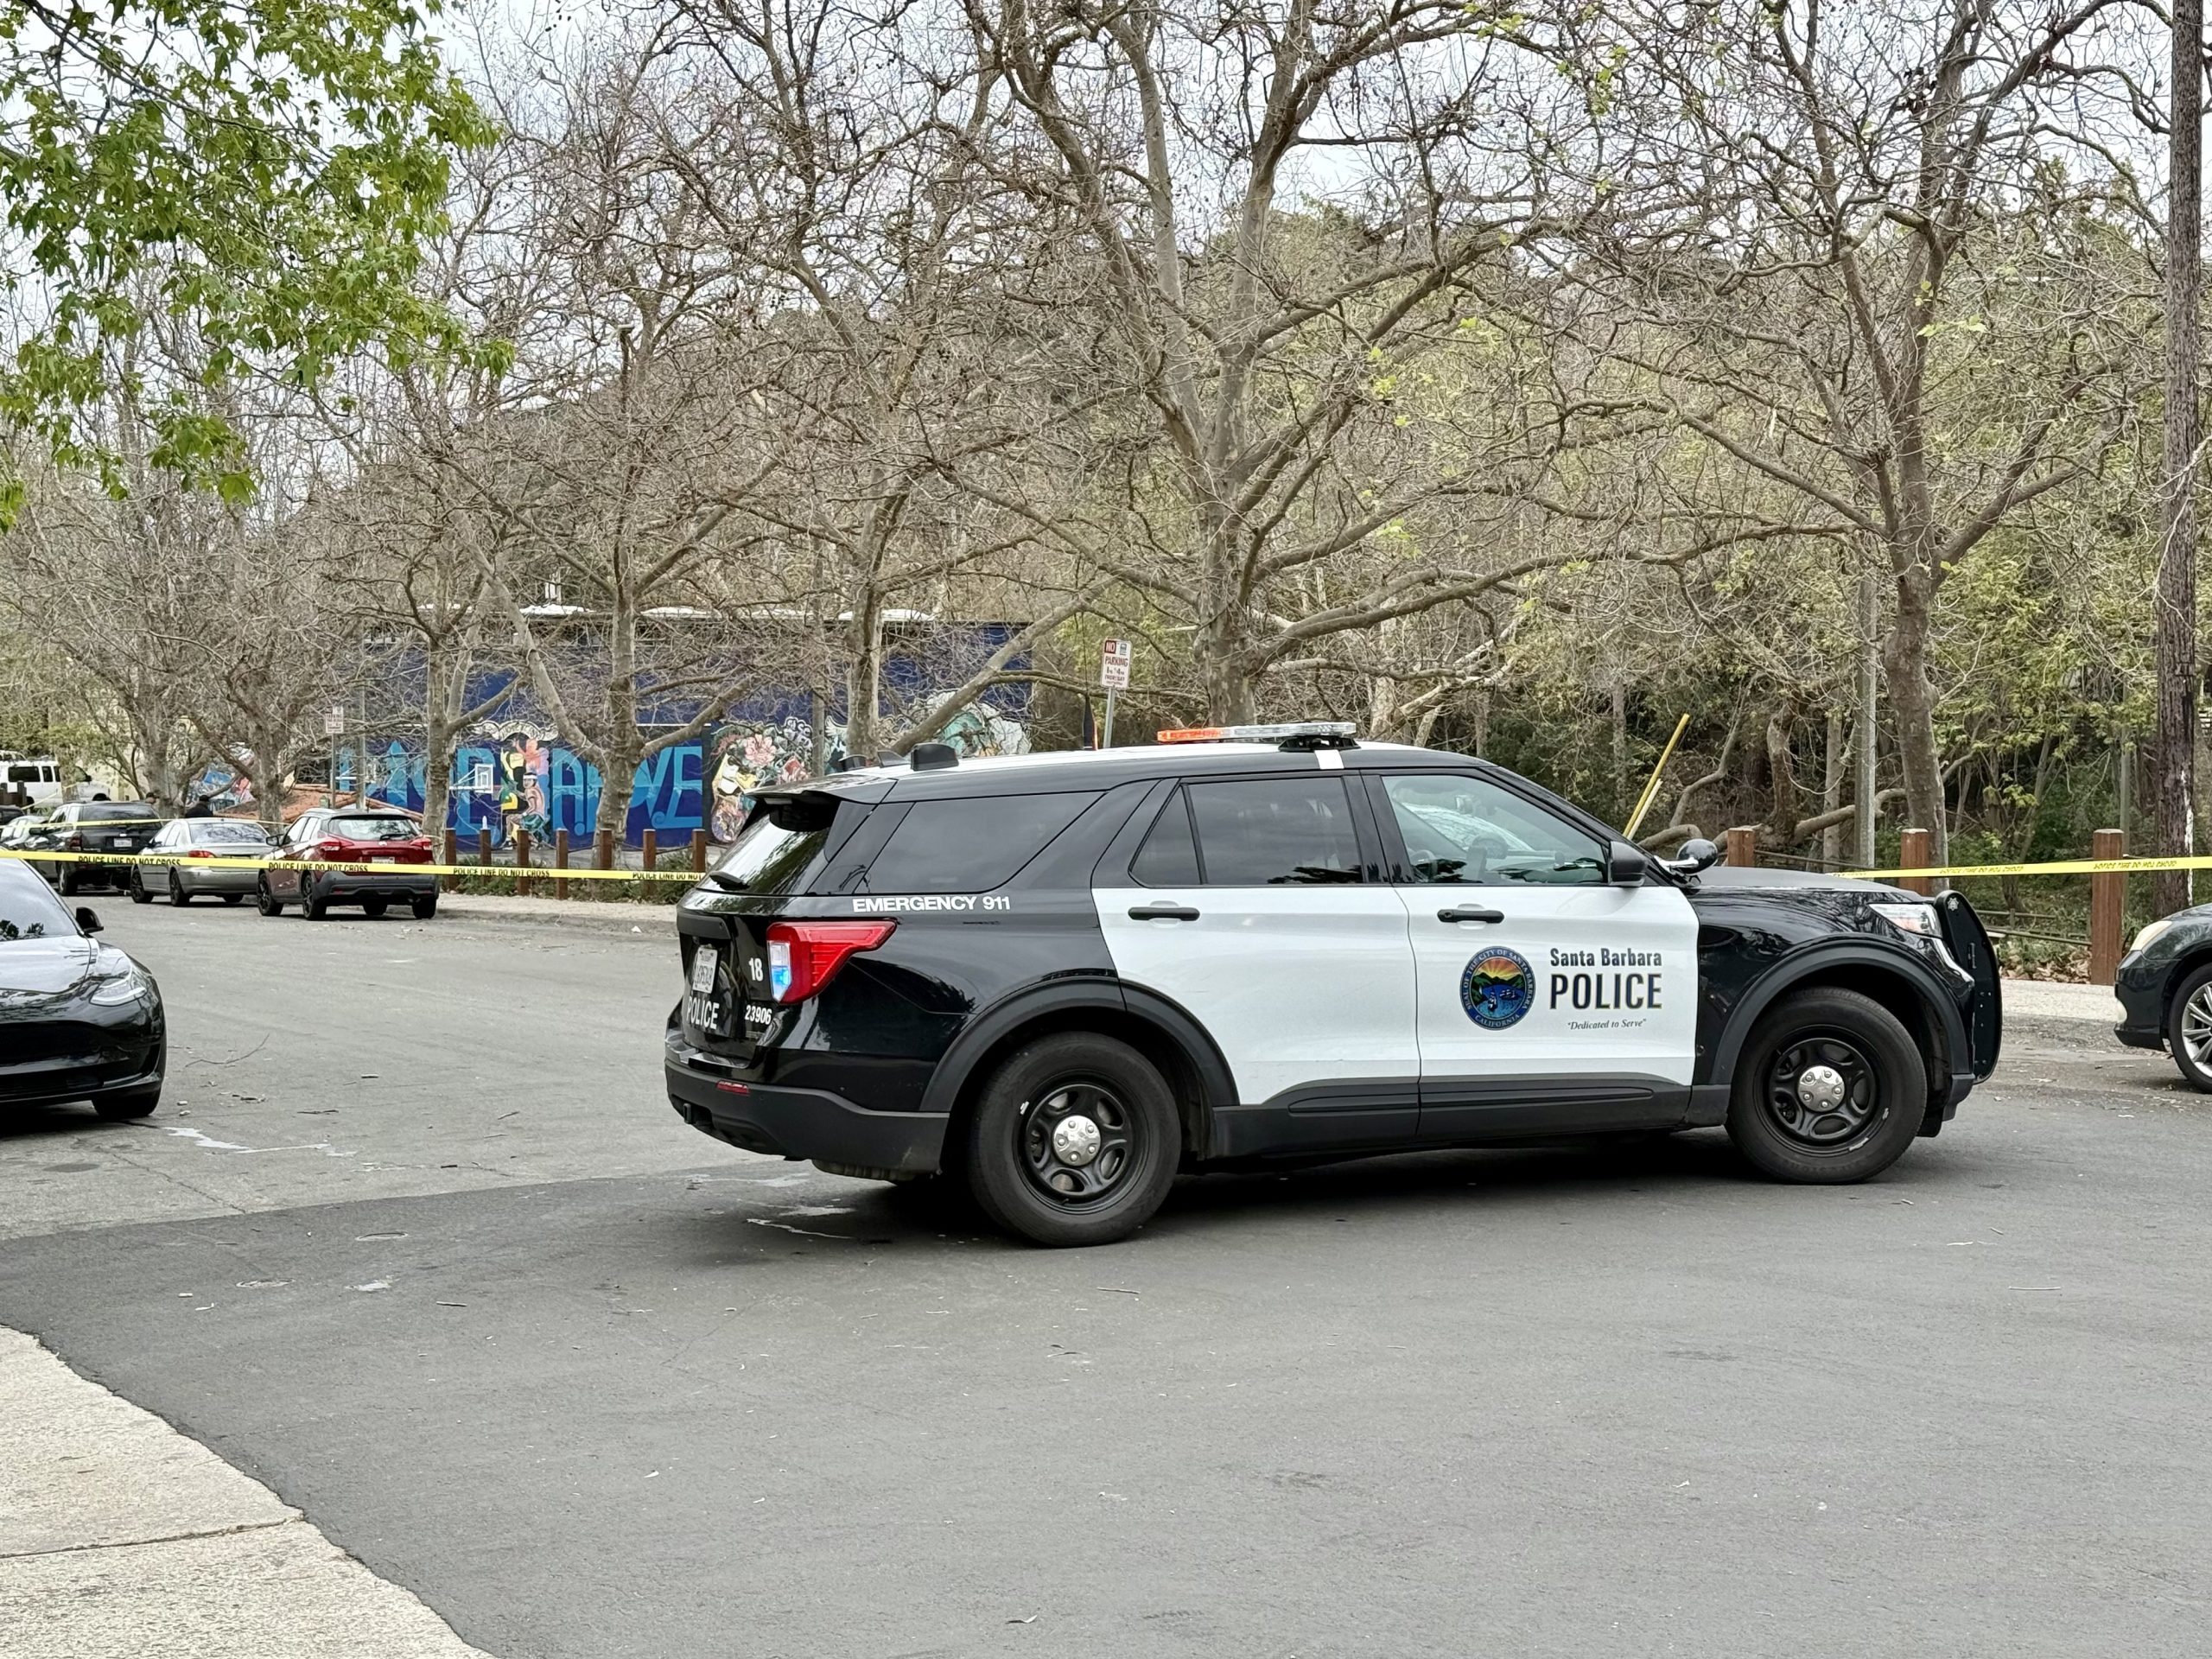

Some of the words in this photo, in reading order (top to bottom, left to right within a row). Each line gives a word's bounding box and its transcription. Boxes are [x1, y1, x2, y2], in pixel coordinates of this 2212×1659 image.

[1106, 642, 1115, 652] NO
[1105, 656, 1128, 667] PARKING
[852, 896, 976, 912] EMERGENCY
[982, 896, 1011, 910] 911
[1478, 950, 1495, 961] CITY
[1508, 951, 1529, 973] SANTA
[1550, 947, 1595, 966] Santa
[1600, 947, 1662, 966] Barbara
[748, 957, 764, 982] 18
[1549, 973, 1662, 1009] POLICE
[687, 996, 720, 1030] POLICE
[745, 1005, 772, 1025] 23906
[1474, 1014, 1521, 1027] CALIFORNIA
